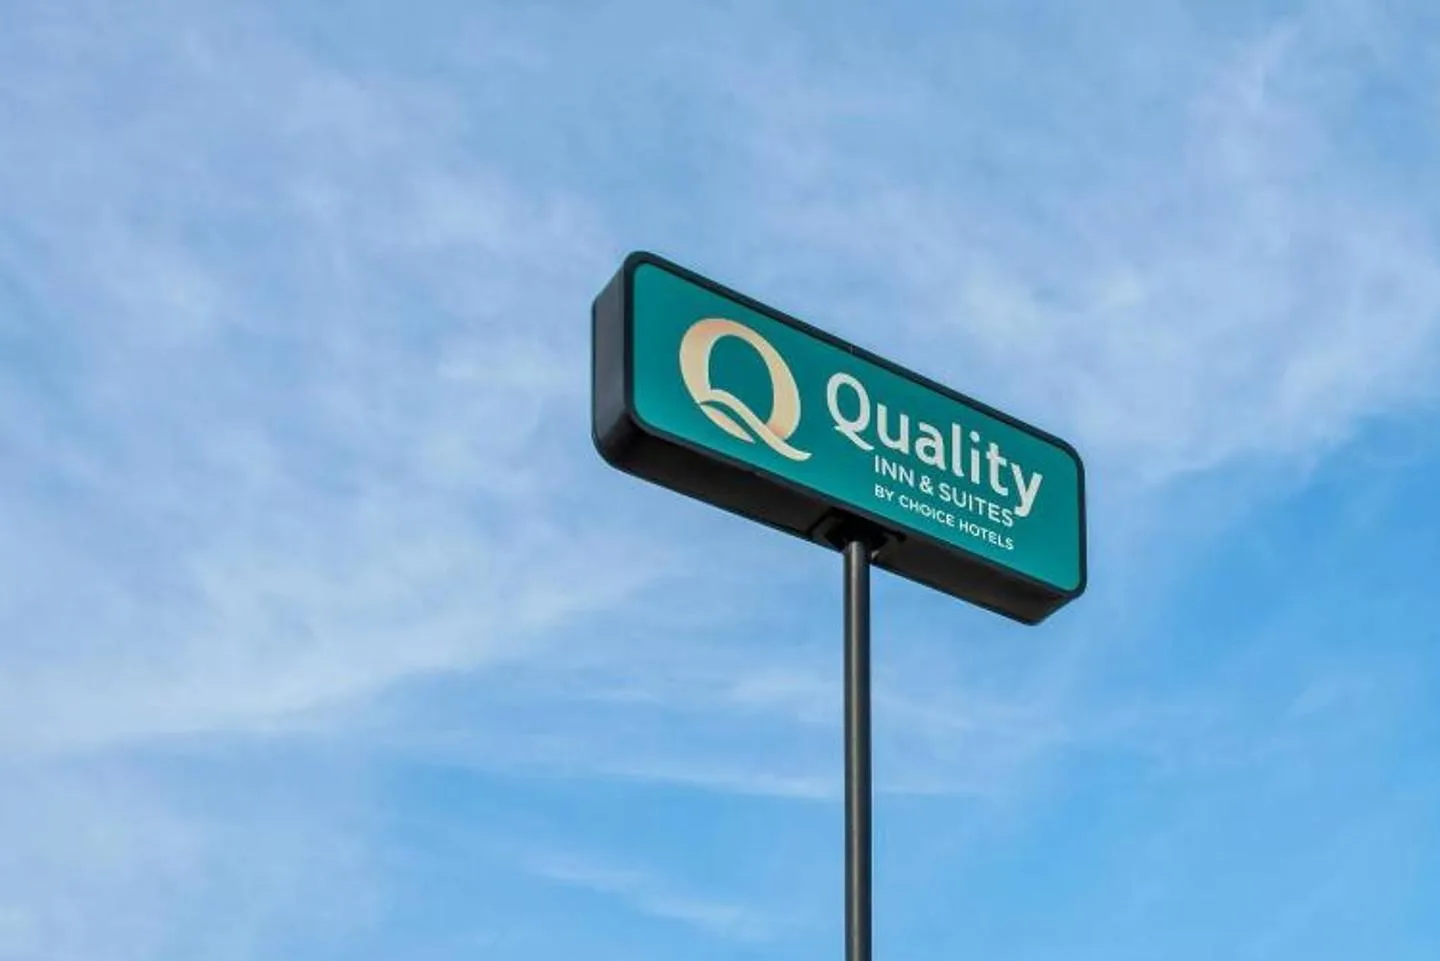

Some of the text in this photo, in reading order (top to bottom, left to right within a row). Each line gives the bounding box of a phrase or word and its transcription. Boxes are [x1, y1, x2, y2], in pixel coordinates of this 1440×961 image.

[680, 318, 811, 461] Q
[826, 373, 1043, 517] Quality
[874, 455, 1013, 528] INN & SUITES
[874, 483, 1014, 550] BY CHOICE HOTELS
